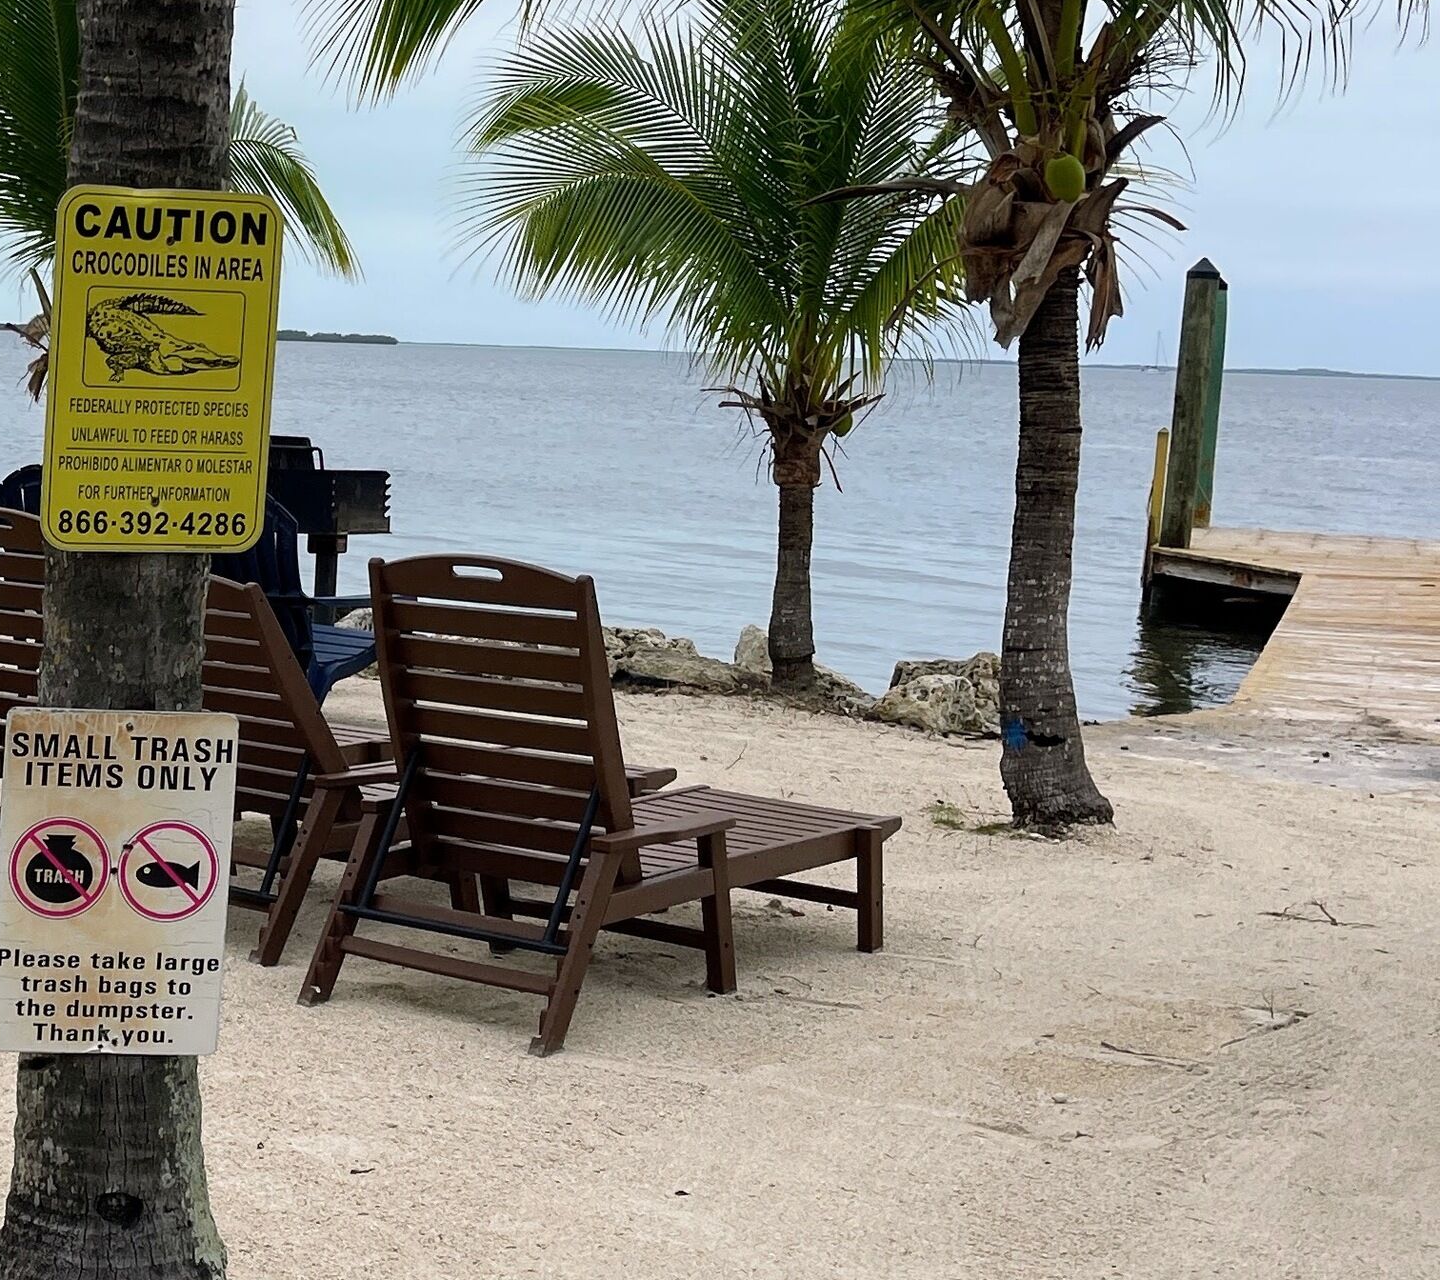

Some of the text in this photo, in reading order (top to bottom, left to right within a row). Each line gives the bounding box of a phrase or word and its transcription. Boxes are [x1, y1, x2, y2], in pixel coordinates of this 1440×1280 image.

[74, 204, 267, 246] CAUTION
[72, 251, 264, 282] CROCODILES IN AREA
[69, 398, 249, 418] FEDERALLY PROTECTED SPECIES
[72, 428, 243, 446] UNLAWFUL TO FEED OR HARASS
[59, 456, 252, 474] PROHIBIDO ALIMENTAR O MOLESTAR
[78, 485, 230, 502] FOR FURTHER INFORMATION
[11, 733, 233, 763] SMALL TRASH
[25, 763, 218, 791] ITEMS ONLY
[91, 952, 146, 970] take
[156, 952, 219, 976] large
[21, 976, 192, 998] trash bags to
[16, 999, 193, 1022] the dumpster.
[33, 1023, 174, 1046] Thank you.
